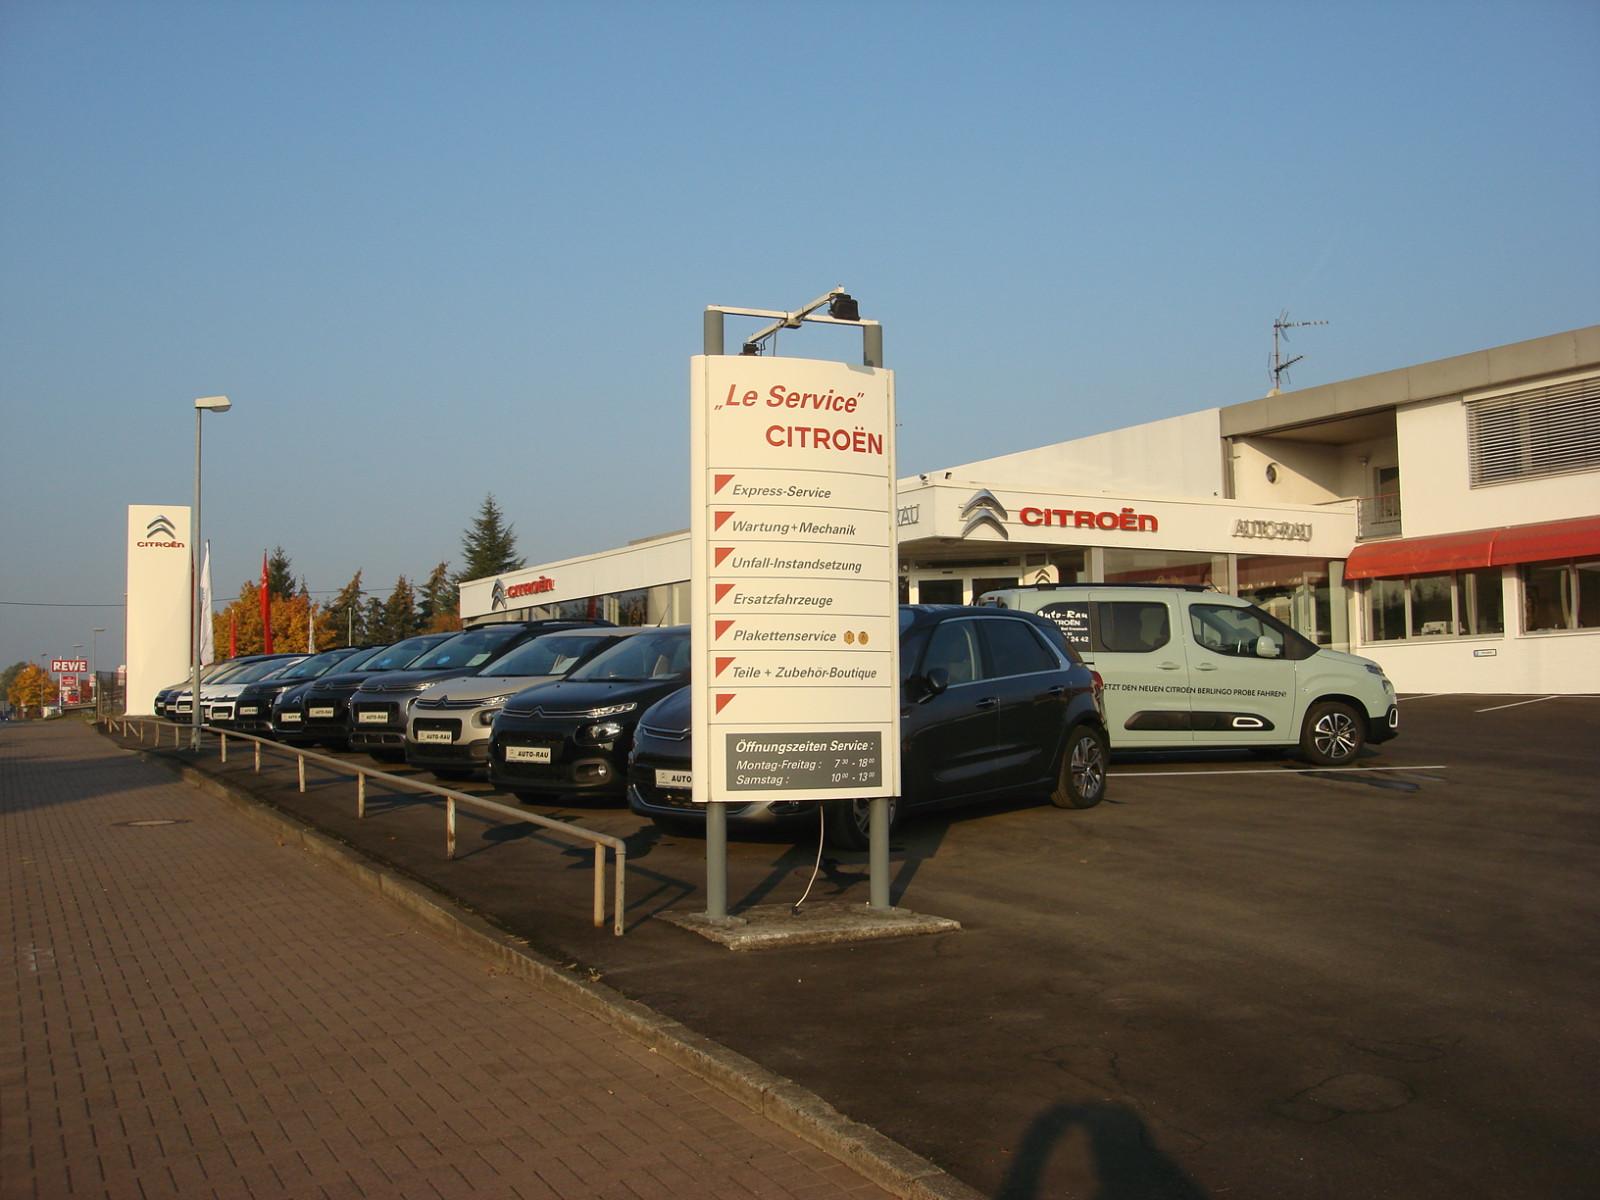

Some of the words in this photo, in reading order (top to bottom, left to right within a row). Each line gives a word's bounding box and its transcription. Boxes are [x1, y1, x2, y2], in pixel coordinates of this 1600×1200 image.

[765, 425, 883, 455] CITROËN
[732, 484, 832, 499] Express-Service
[731, 556, 863, 574] Unfall-Instandsetzung
[733, 593, 834, 609] Ersatzfahrzeuge
[733, 629, 837, 643] Plakettenservice
[53, 661, 87, 672] REWE
[732, 666, 761, 679] Teile
[775, 666, 878, 682] Zubehör-Boutique
[1103, 683, 1121, 692] ETZT
[1122, 684, 1138, 692] DEN
[1138, 685, 1164, 693] NEUEN
[1197, 687, 1233, 696] BERLINGO
[1233, 688, 1256, 697] PROBE
[517, 750, 549, 759] AUTO-RAU
[735, 739, 827, 755] Öffnungszeiten
[671, 774, 692, 783] AUTO
